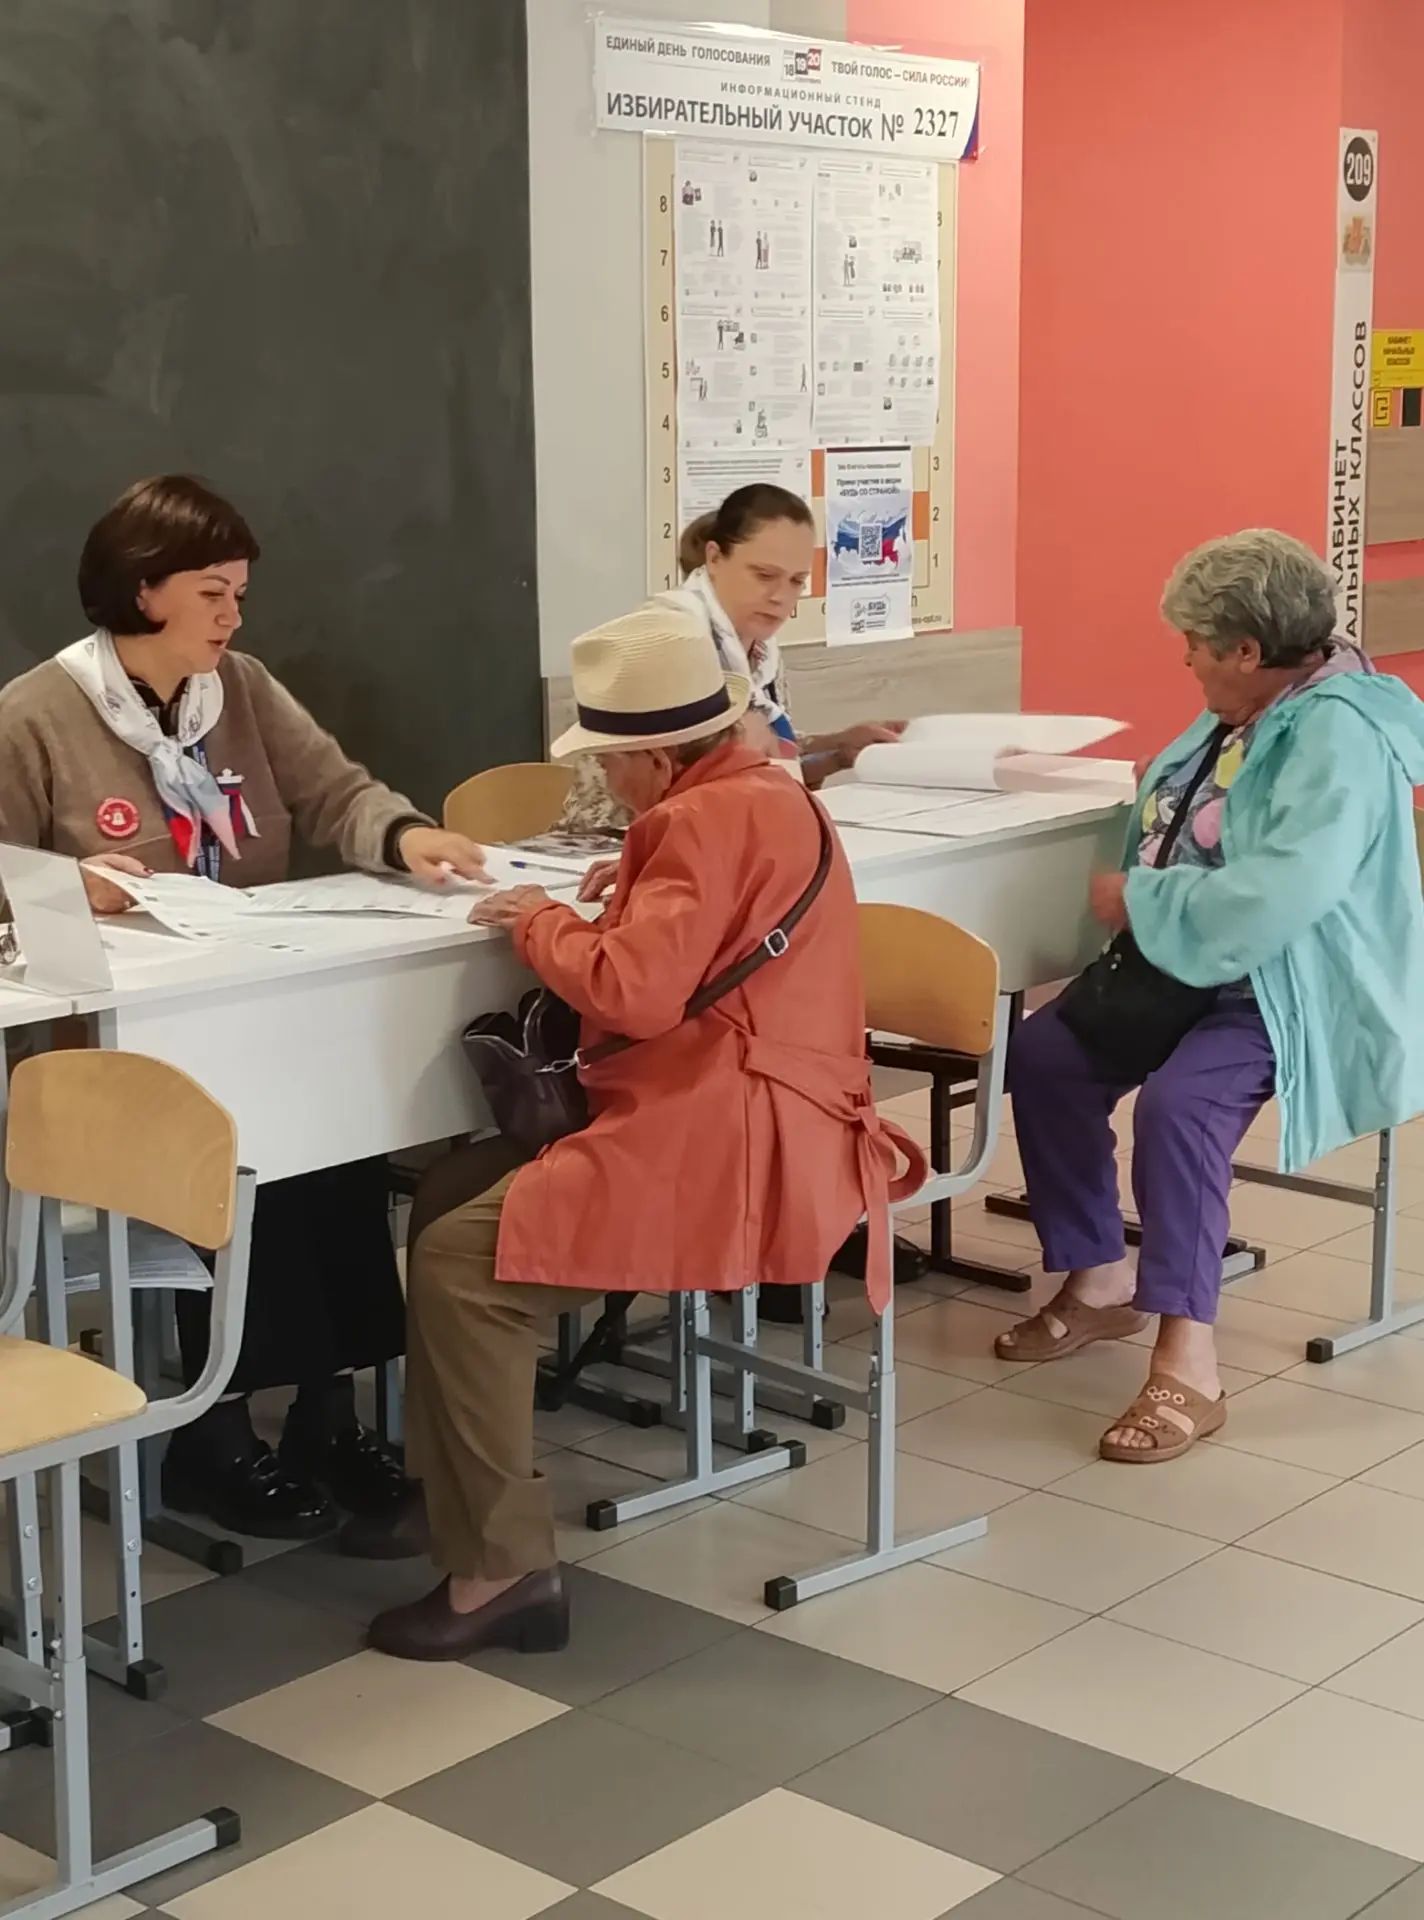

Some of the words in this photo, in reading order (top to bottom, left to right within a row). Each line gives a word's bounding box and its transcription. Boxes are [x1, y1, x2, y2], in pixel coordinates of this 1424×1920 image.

[606, 35, 655, 53] ЕДИНЫЙ
[657, 41, 687, 57] ДЕНЬ
[692, 45, 771, 66] ГОЛОСОВАНИЯ
[831, 60, 859, 76] ТВОЙ
[861, 66, 893, 80] ГОЛОС
[903, 70, 928, 84] СИЛА
[720, 81, 842, 104] ИНФОРМАЦИОННЫЙ
[845, 95, 882, 109] СТЕНД
[607, 92, 782, 131] ИЗБИРАТЕЛЬНЫЙ
[788, 110, 873, 140] УЧАСТОК
[881, 112, 904, 142] №
[913, 107, 959, 138] 2327
[1346, 152, 1372, 186] 209
[659, 195, 668, 213] 8
[660, 249, 668, 266] 7
[661, 305, 669, 322] 6
[661, 362, 670, 379] 5
[1349, 320, 1367, 480] КЛАССОВ
[662, 414, 670, 431] 4
[932, 456, 940, 472] 3
[663, 466, 671, 483] 3
[932, 506, 940, 522] 2
[1332, 439, 1348, 585] АБИНЕТ
[663, 522, 671, 539] 2
[932, 552, 939, 568] 1
[1346, 496, 1361, 638] АЛЬНЫХ
[664, 573, 671, 591] 1
